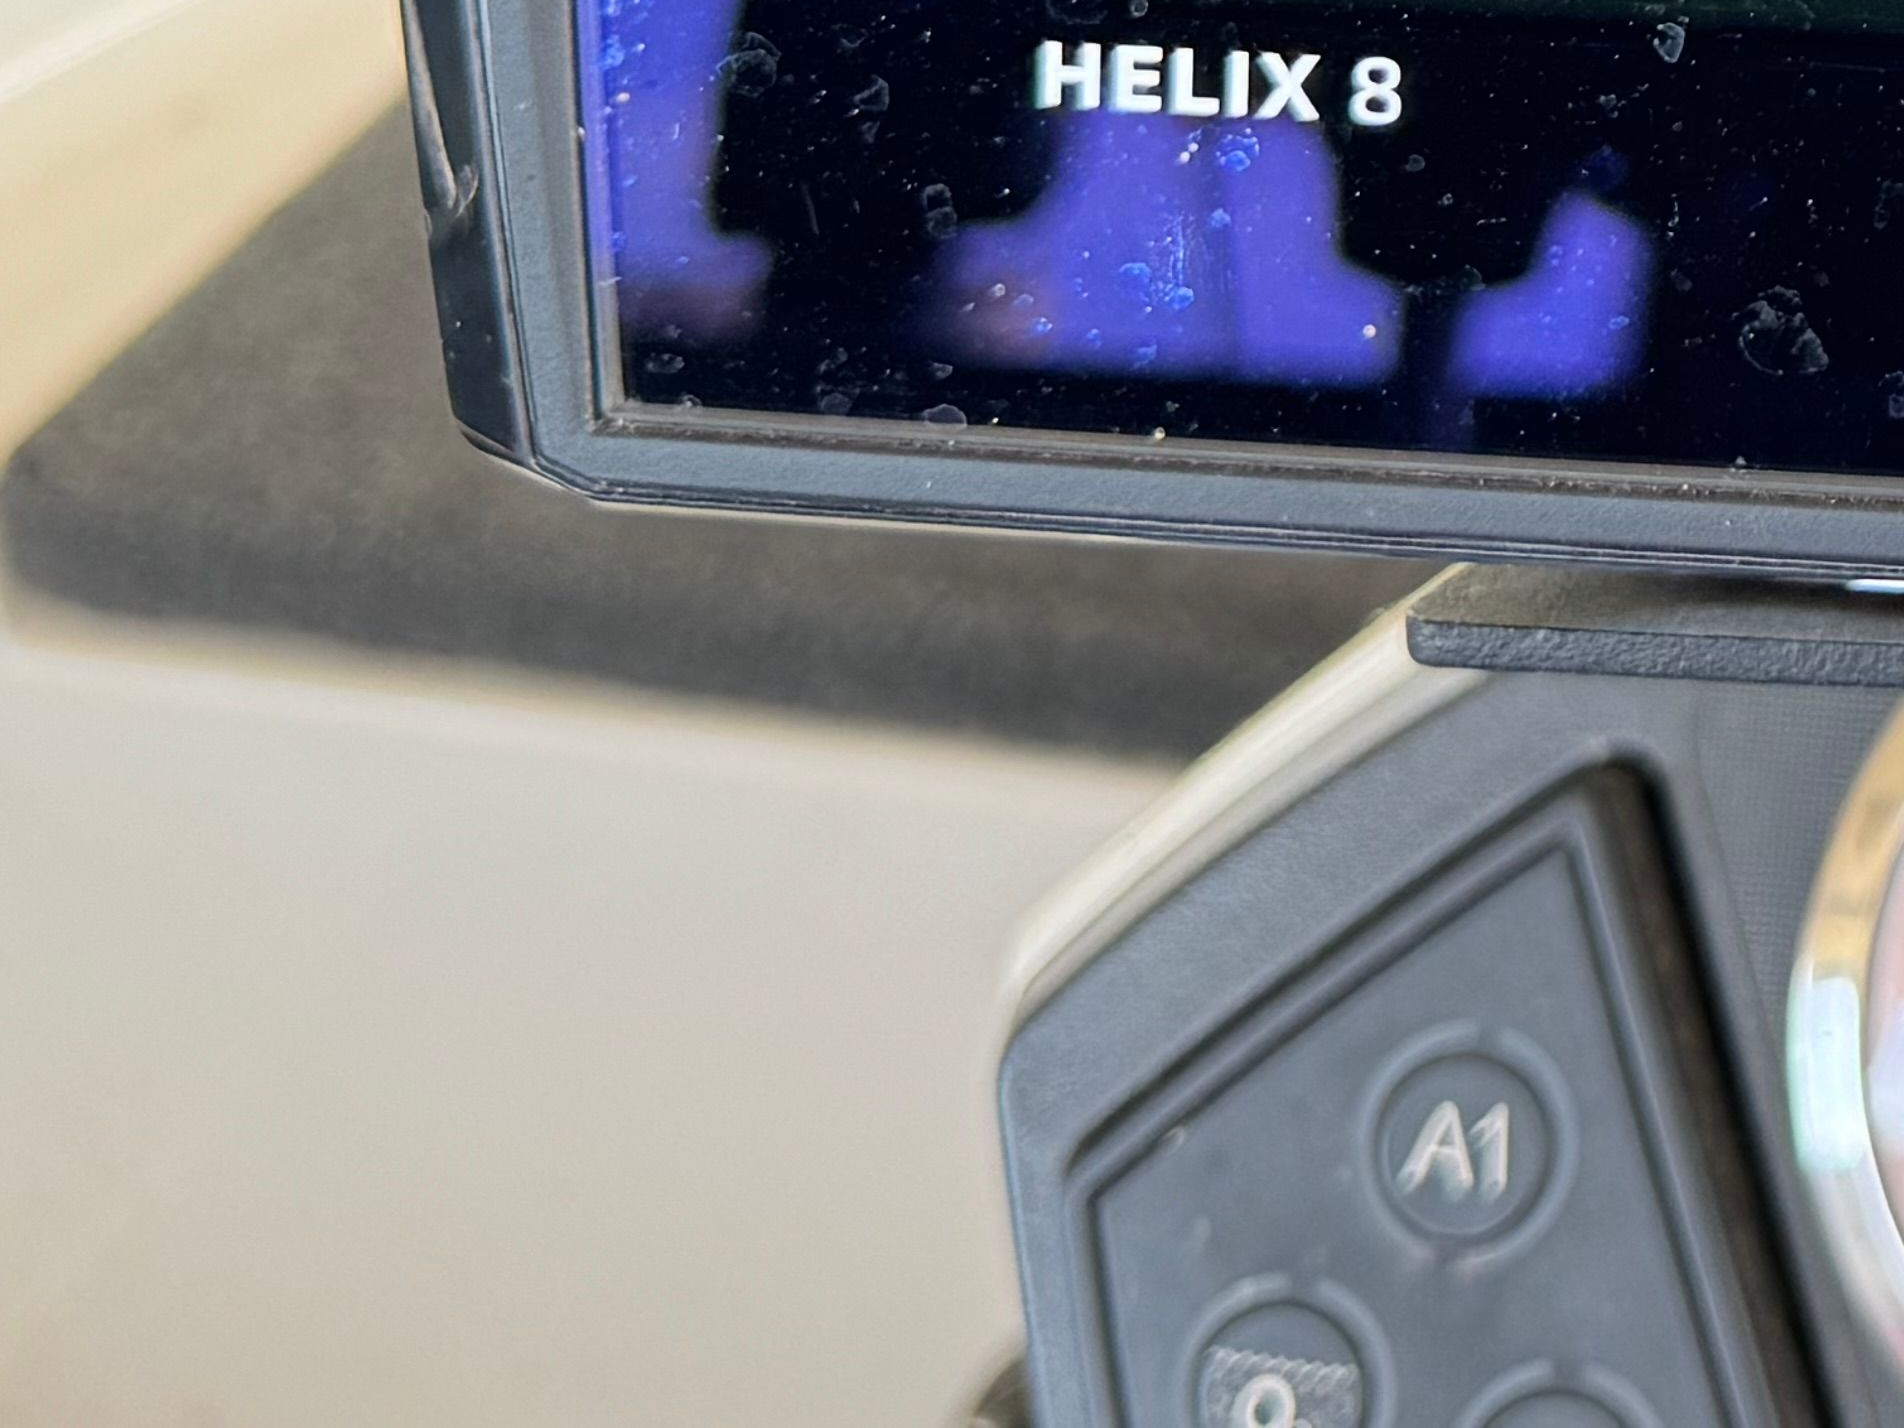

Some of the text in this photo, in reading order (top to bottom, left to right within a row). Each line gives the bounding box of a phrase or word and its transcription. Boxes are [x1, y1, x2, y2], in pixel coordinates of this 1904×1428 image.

[1034, 40, 1403, 127] HELIX 8
[1396, 1100, 1510, 1202] A1
